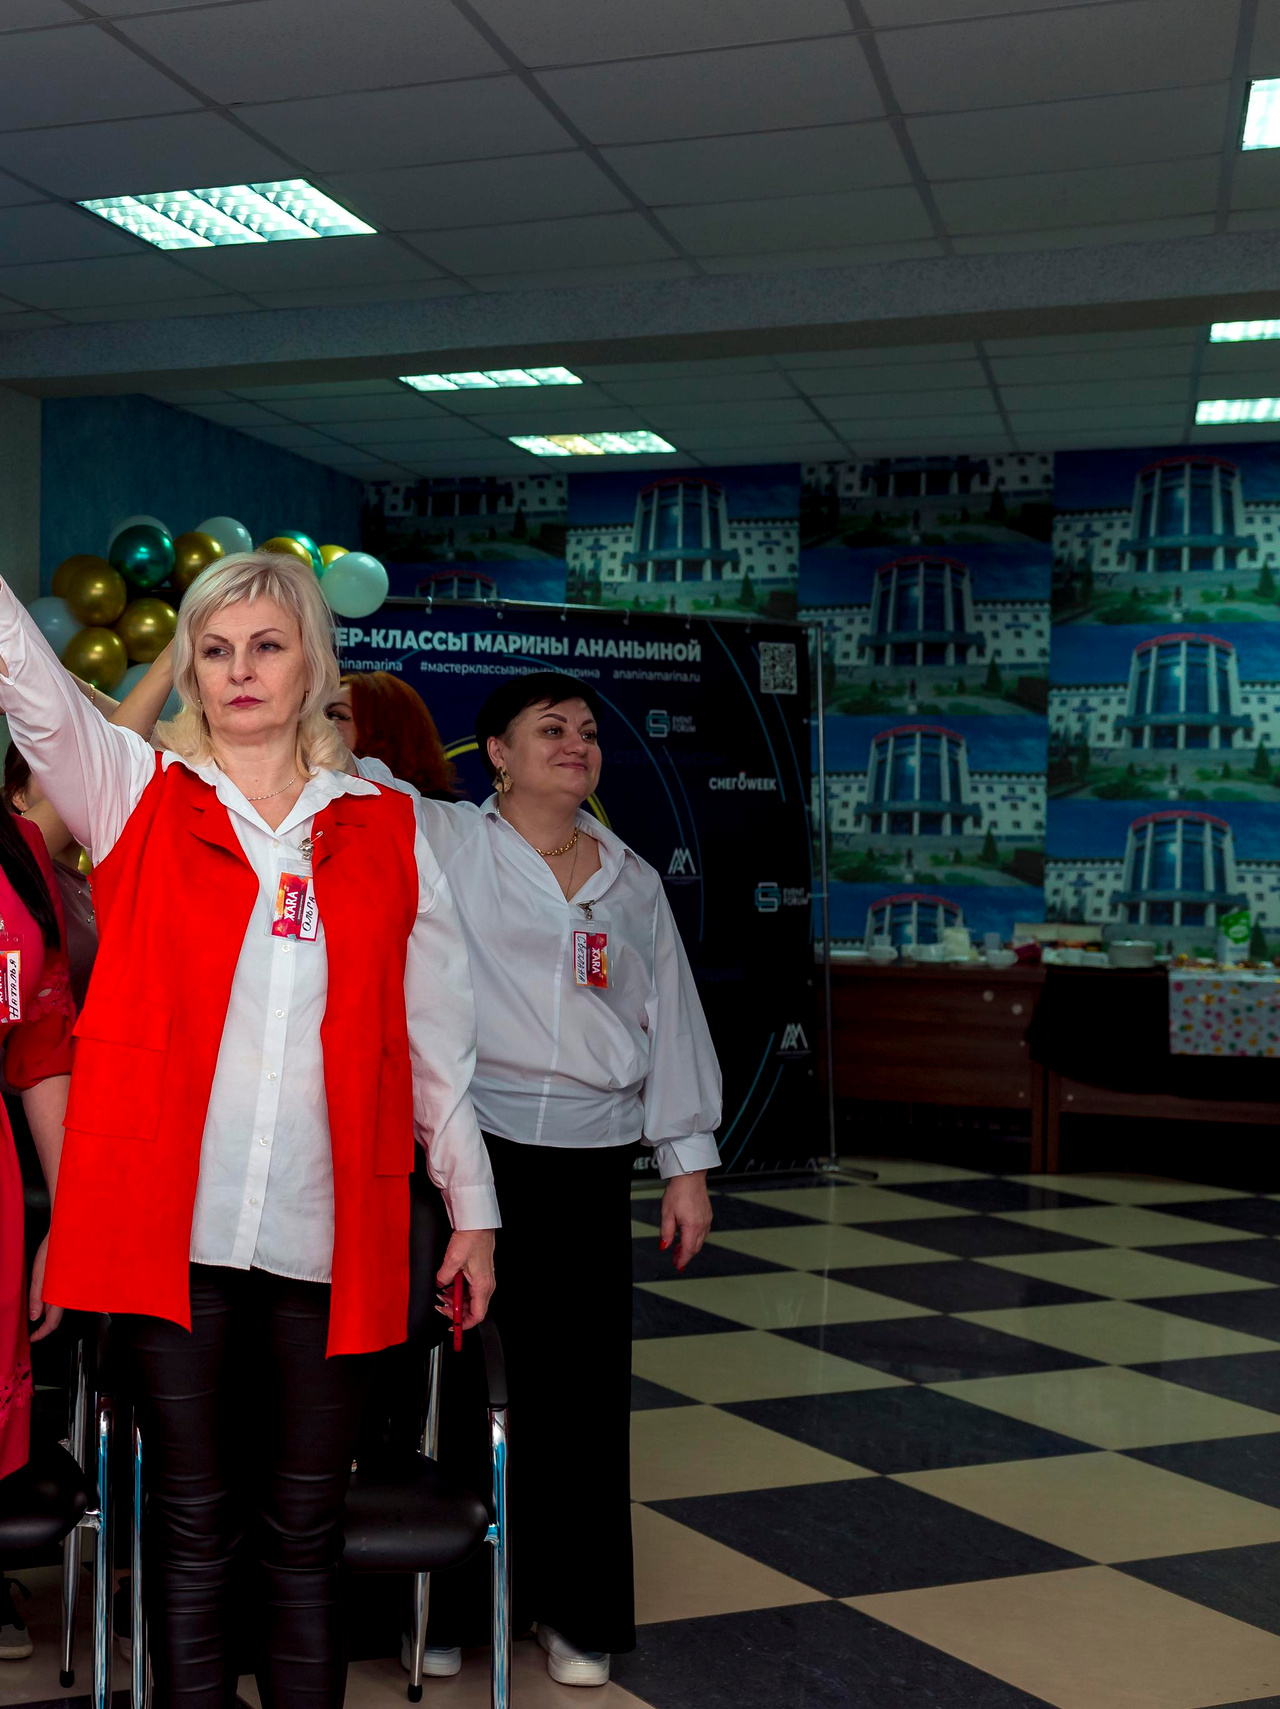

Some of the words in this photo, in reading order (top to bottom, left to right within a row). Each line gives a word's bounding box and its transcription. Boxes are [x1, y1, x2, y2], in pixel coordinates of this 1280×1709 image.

[332, 627, 468, 653] ЕР-КЛАССЫ
[474, 633, 569, 656] МАРИНЫ
[574, 638, 702, 662] АНАНЬИНОЙ
[612, 668, 701, 682] ananinamarina.ru
